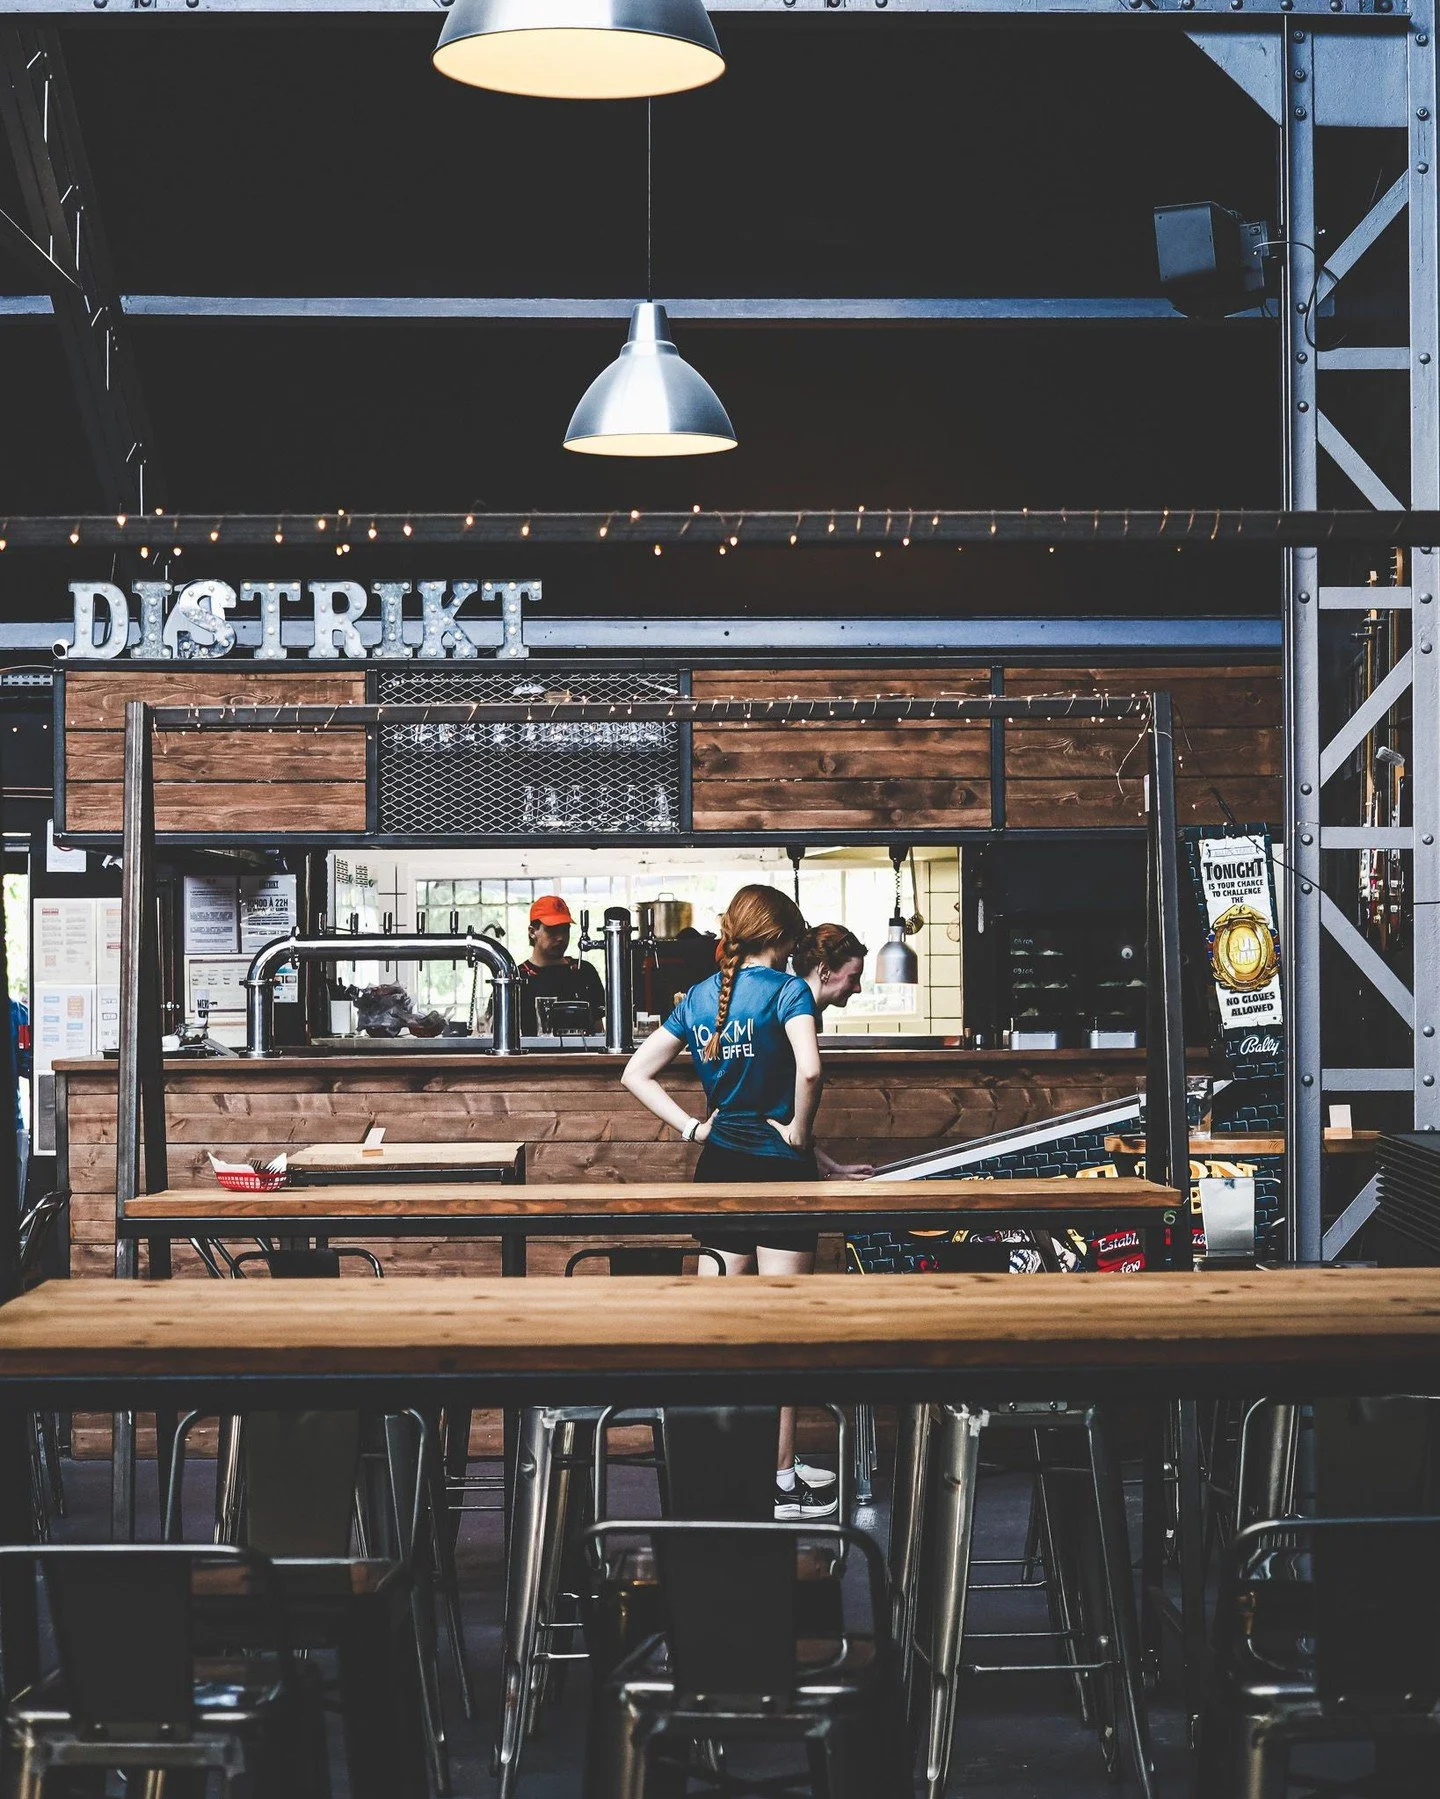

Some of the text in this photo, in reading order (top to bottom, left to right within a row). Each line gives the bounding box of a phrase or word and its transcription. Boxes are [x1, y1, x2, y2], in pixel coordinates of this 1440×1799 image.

[67, 578, 543, 659] DISTRIKT
[1203, 857, 1264, 881] TONIGHT
[1217, 881, 1235, 889] YOUR
[1237, 879, 1264, 888] CHANCE
[1222, 887, 1261, 896] CHALLENGE
[275, 898, 289, 907] 22H
[1231, 896, 1244, 904] THE
[1226, 991, 1275, 1006] NO GLOVES
[1231, 1003, 1274, 1017] ALLOWED
[1240, 1035, 1279, 1056] Bally
[1097, 1232, 1207, 1252] Establ 18
